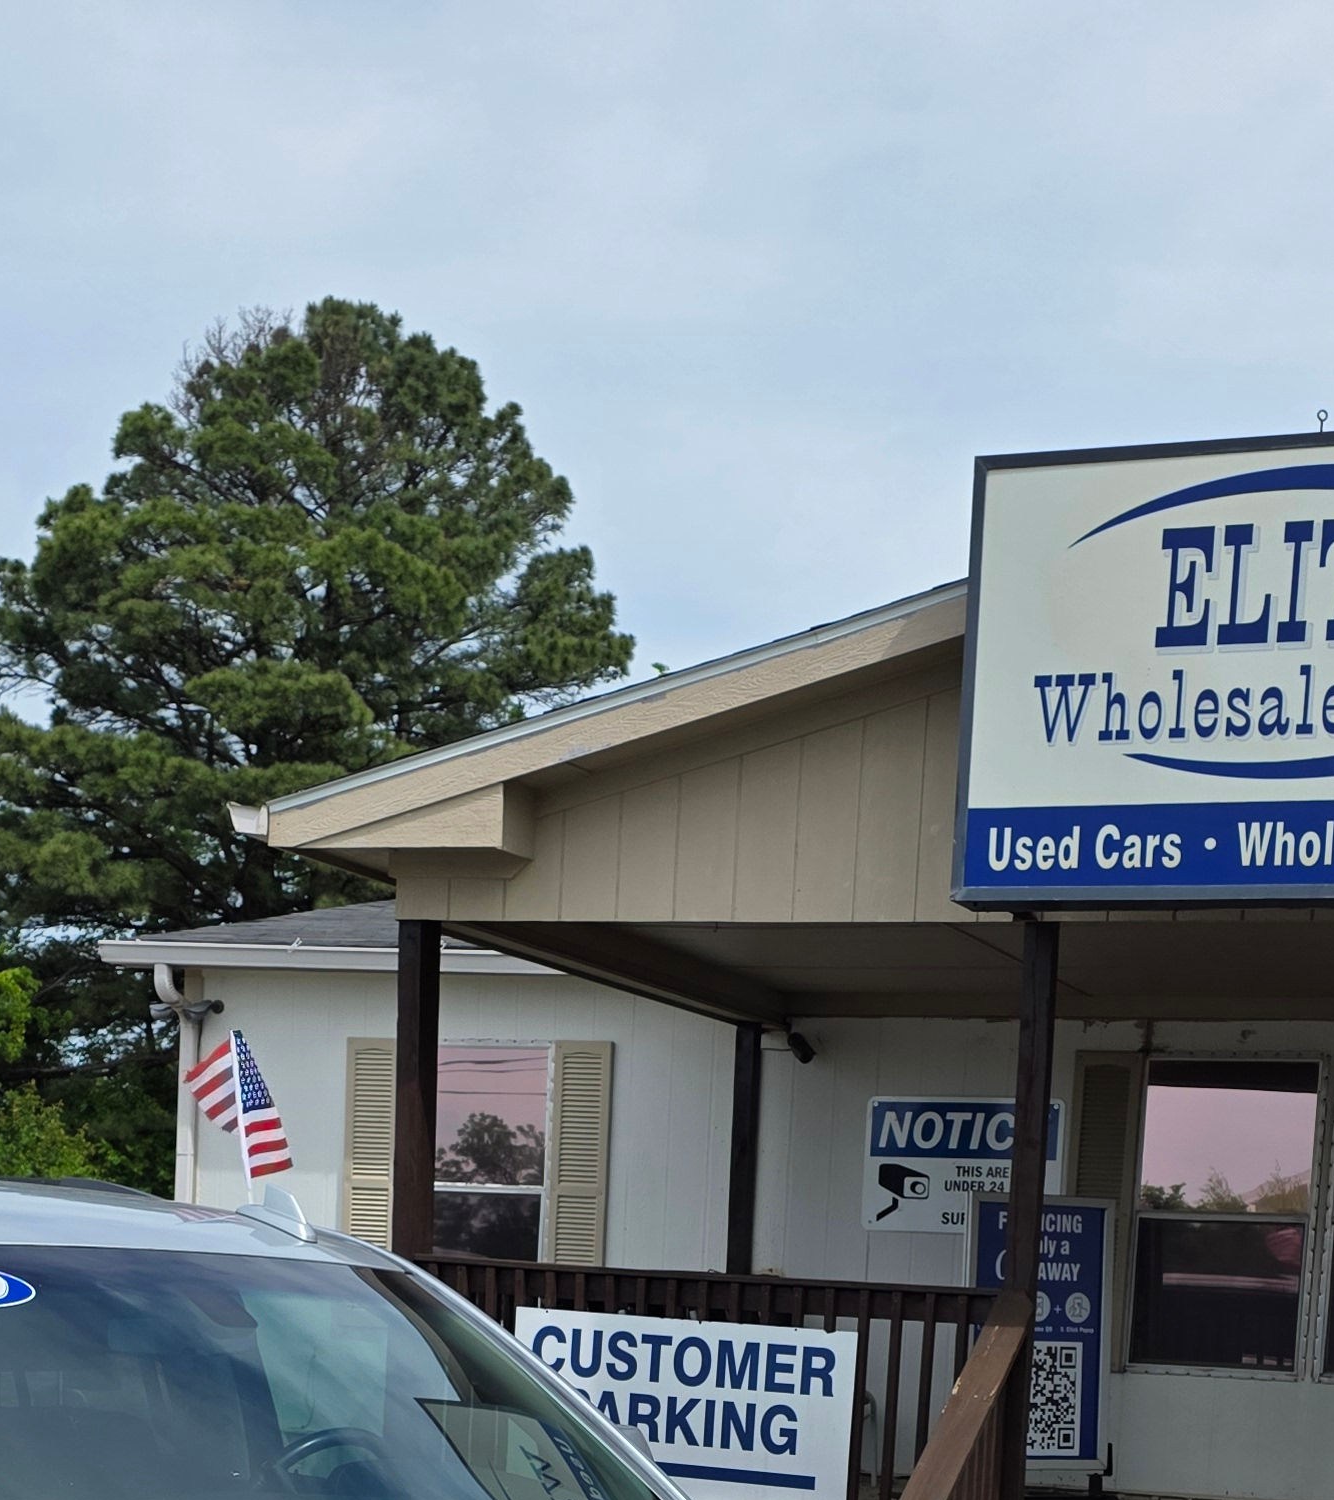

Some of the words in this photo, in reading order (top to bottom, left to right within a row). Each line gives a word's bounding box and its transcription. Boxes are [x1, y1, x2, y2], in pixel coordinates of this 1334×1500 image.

[988, 825, 1080, 871] Used
[1095, 823, 1183, 868] Cars
[879, 1111, 1016, 1151] NOTIC
[944, 1180, 985, 1192] UNDER
[955, 1166, 982, 1178] THIS
[986, 1167, 1010, 1179] ARE
[1060, 1240, 1071, 1255] a
[1038, 1262, 1081, 1281] AWAY
[533, 1325, 836, 1397] CUSTOMER
[575, 1389, 798, 1455] ARKING
